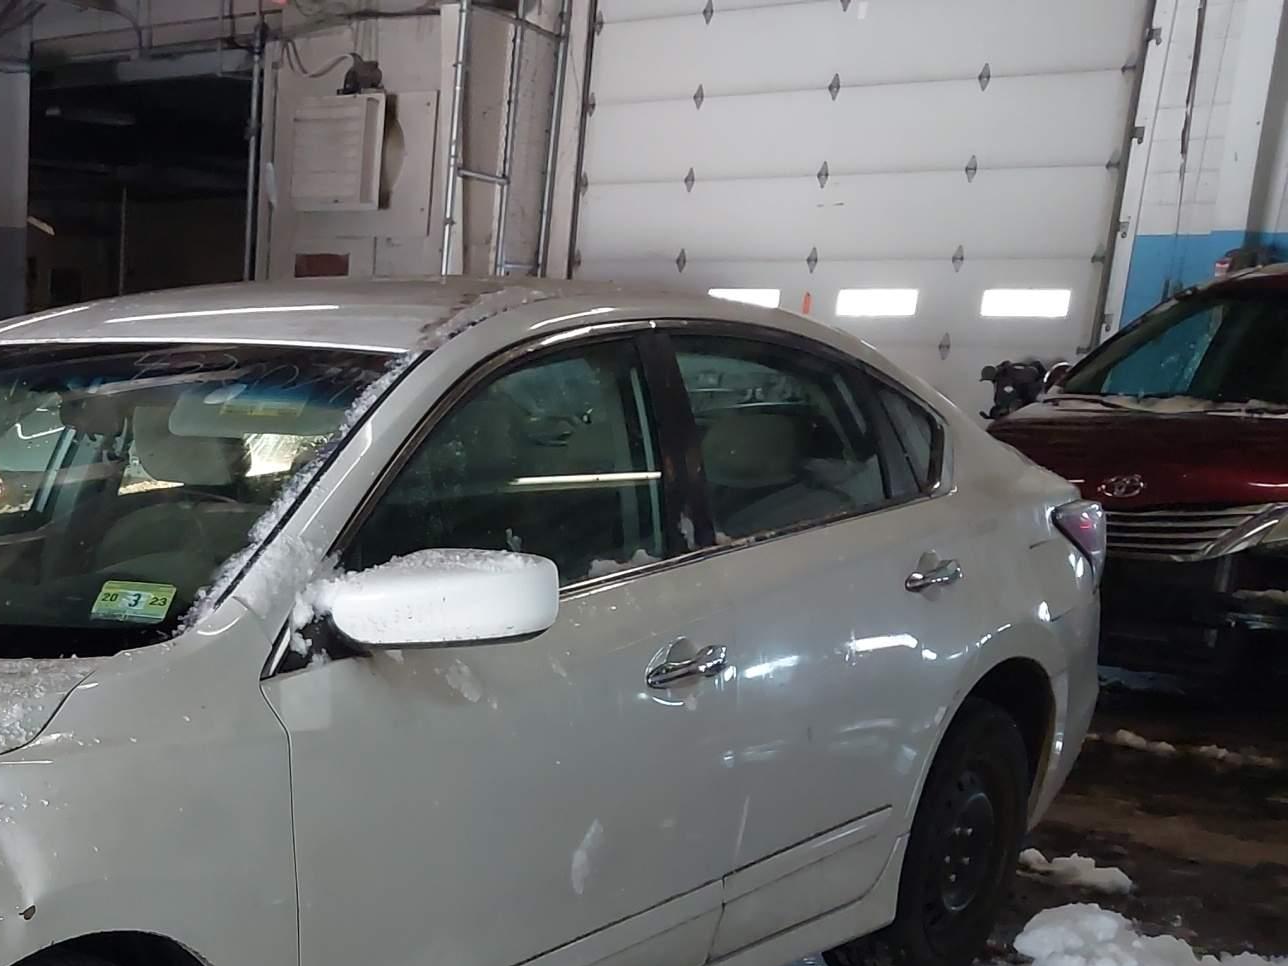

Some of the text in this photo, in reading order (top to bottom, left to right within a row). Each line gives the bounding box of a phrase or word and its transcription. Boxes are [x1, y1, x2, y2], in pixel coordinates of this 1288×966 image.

[101, 592, 168, 608] 20 3 23
